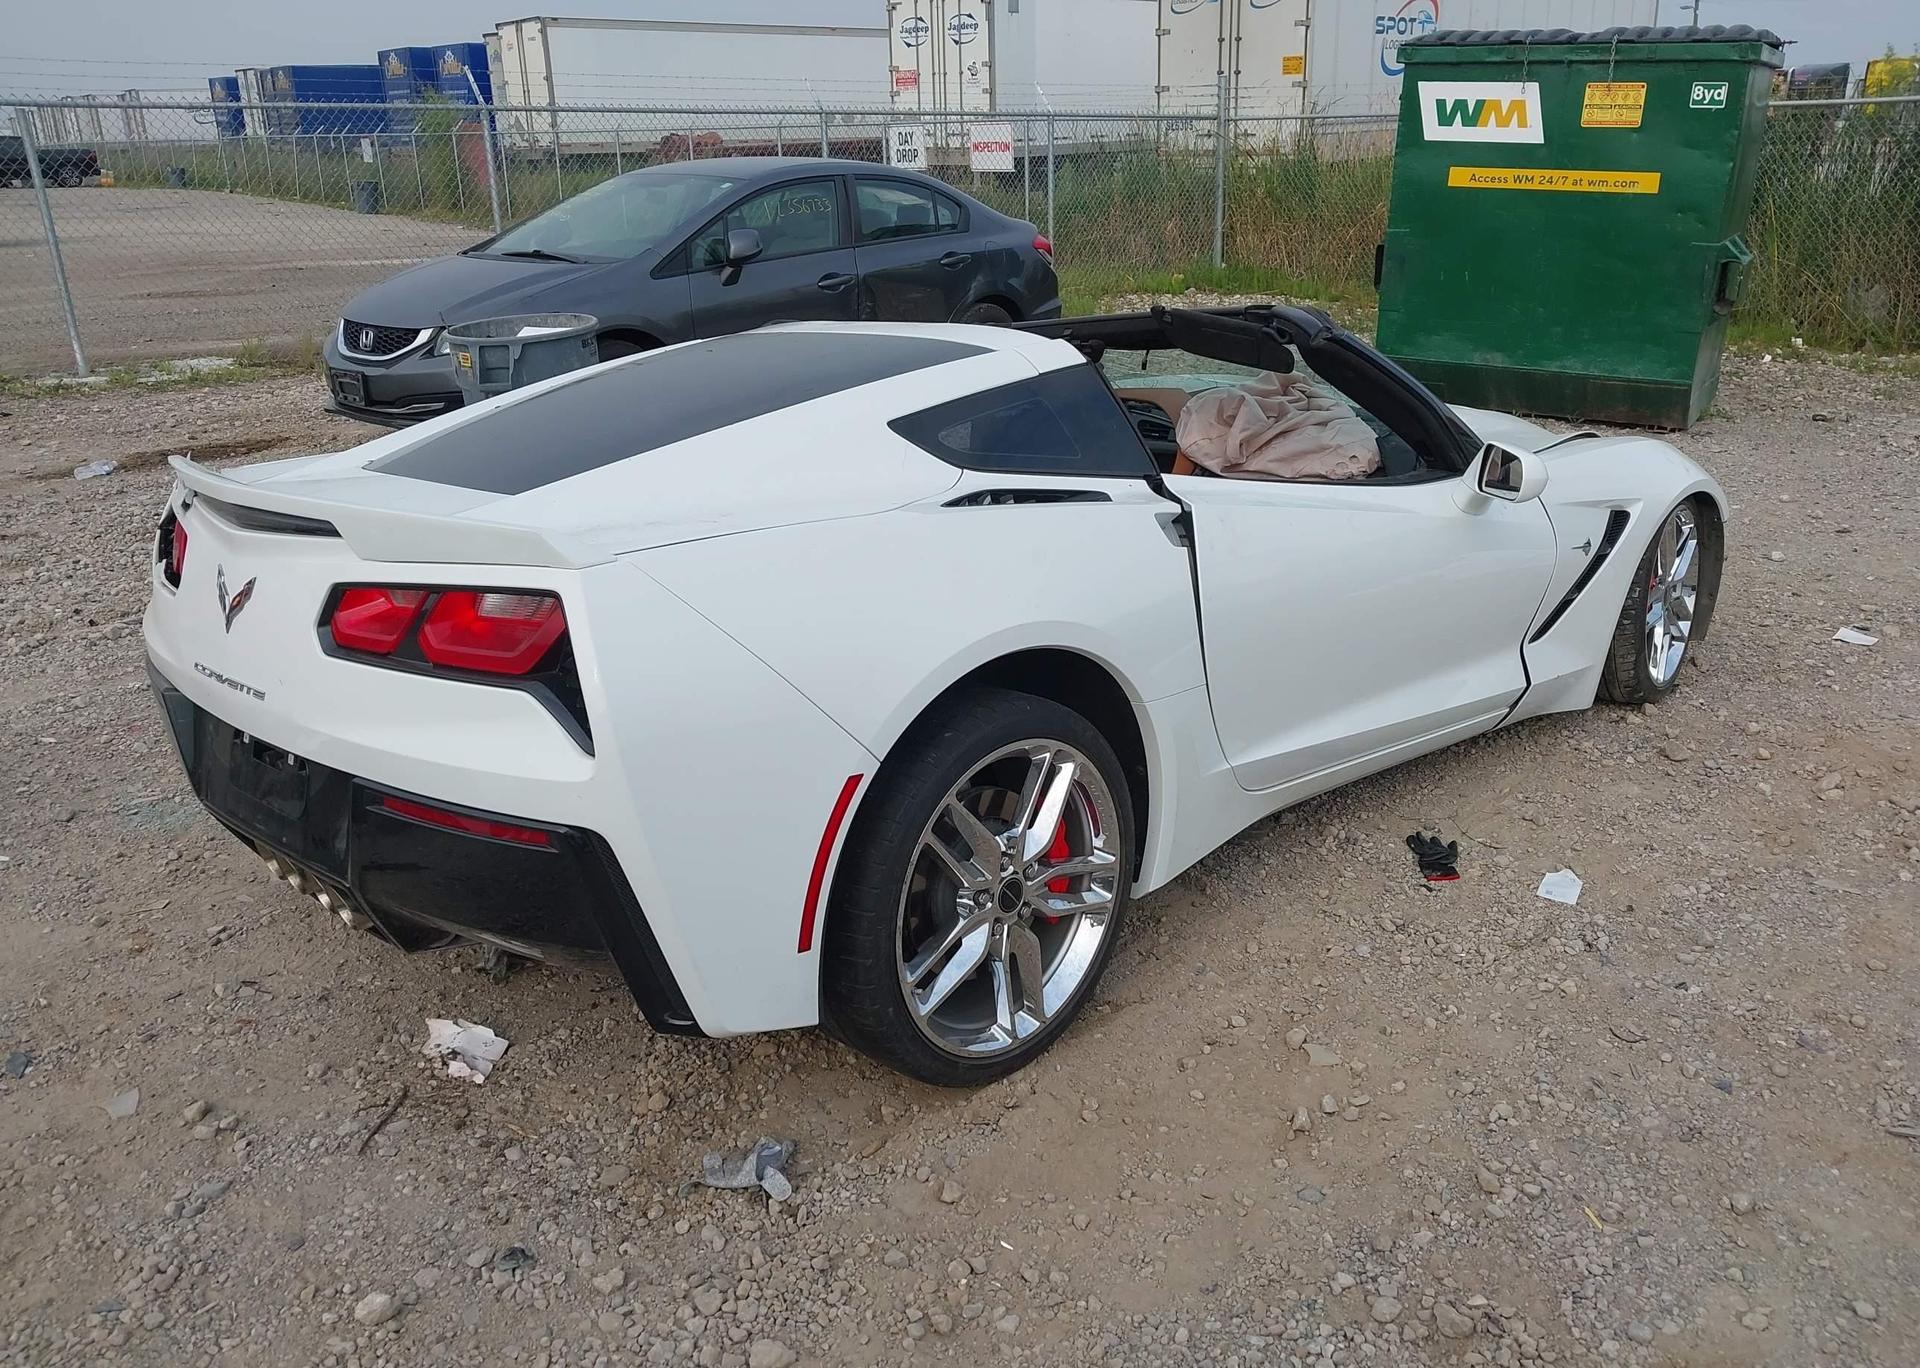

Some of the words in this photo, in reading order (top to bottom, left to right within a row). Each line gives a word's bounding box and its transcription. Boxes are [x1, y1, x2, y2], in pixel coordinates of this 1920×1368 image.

[1375, 16, 1417, 35] SPOT
[1693, 85, 1725, 104] 8yd
[1435, 98, 1528, 128] WM
[898, 131, 914, 146] DAY
[972, 141, 1011, 153] INSPECTION
[896, 148, 919, 163] DROP
[1468, 173, 1508, 184] Access
[1512, 174, 1534, 185] WM
[1538, 175, 1568, 187] 24/7
[1571, 177, 1583, 187] at
[1587, 179, 1640, 189] wm.com
[193, 661, 266, 702] CORVETTE
